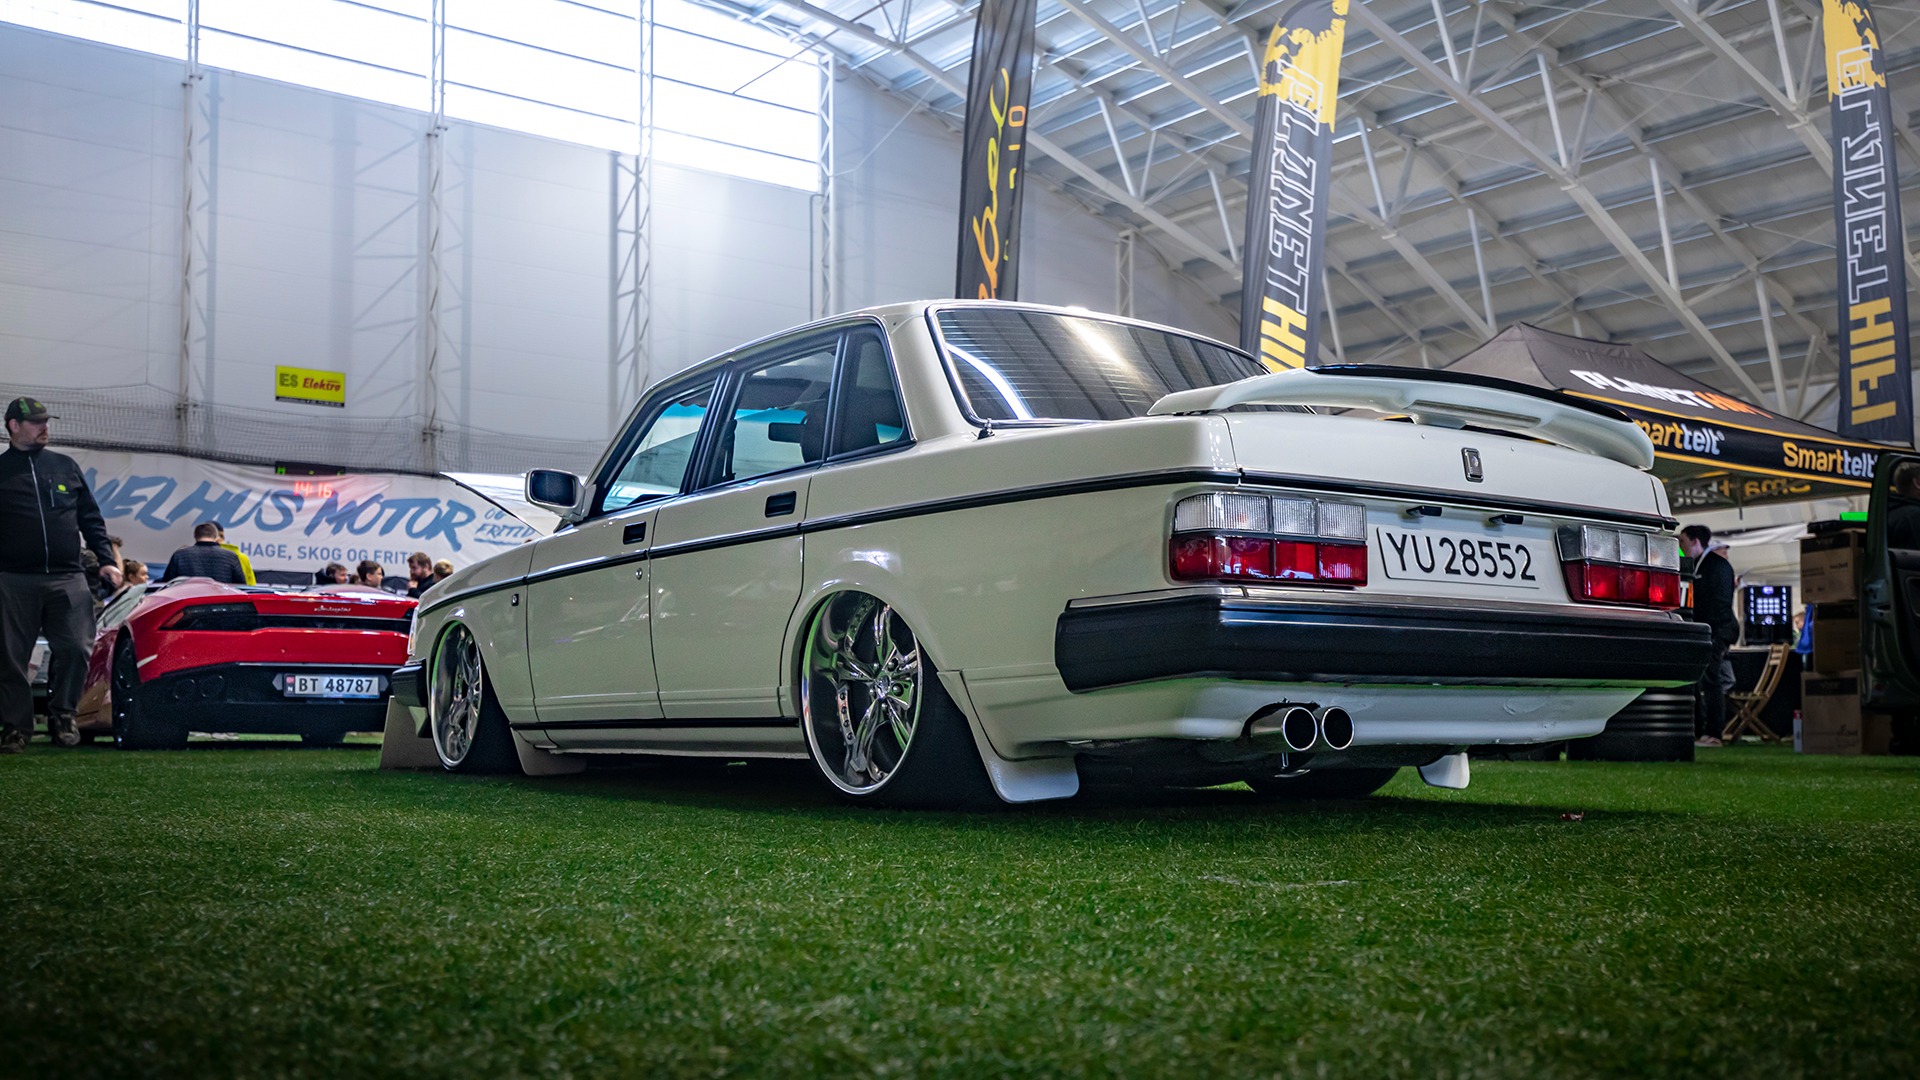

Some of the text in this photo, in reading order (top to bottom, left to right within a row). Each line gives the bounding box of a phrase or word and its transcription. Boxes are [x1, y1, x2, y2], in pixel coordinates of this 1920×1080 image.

[1260, 59, 1323, 373] PLANETHI
[279, 373, 341, 392] ES Elektro
[1635, 419, 1722, 455] marttelt
[294, 481, 333, 498] 14:16
[304, 491, 476, 552] MOTOR
[241, 542, 412, 565] HAGE, SKOG OG FRIT
[299, 679, 373, 692] BT 48787
